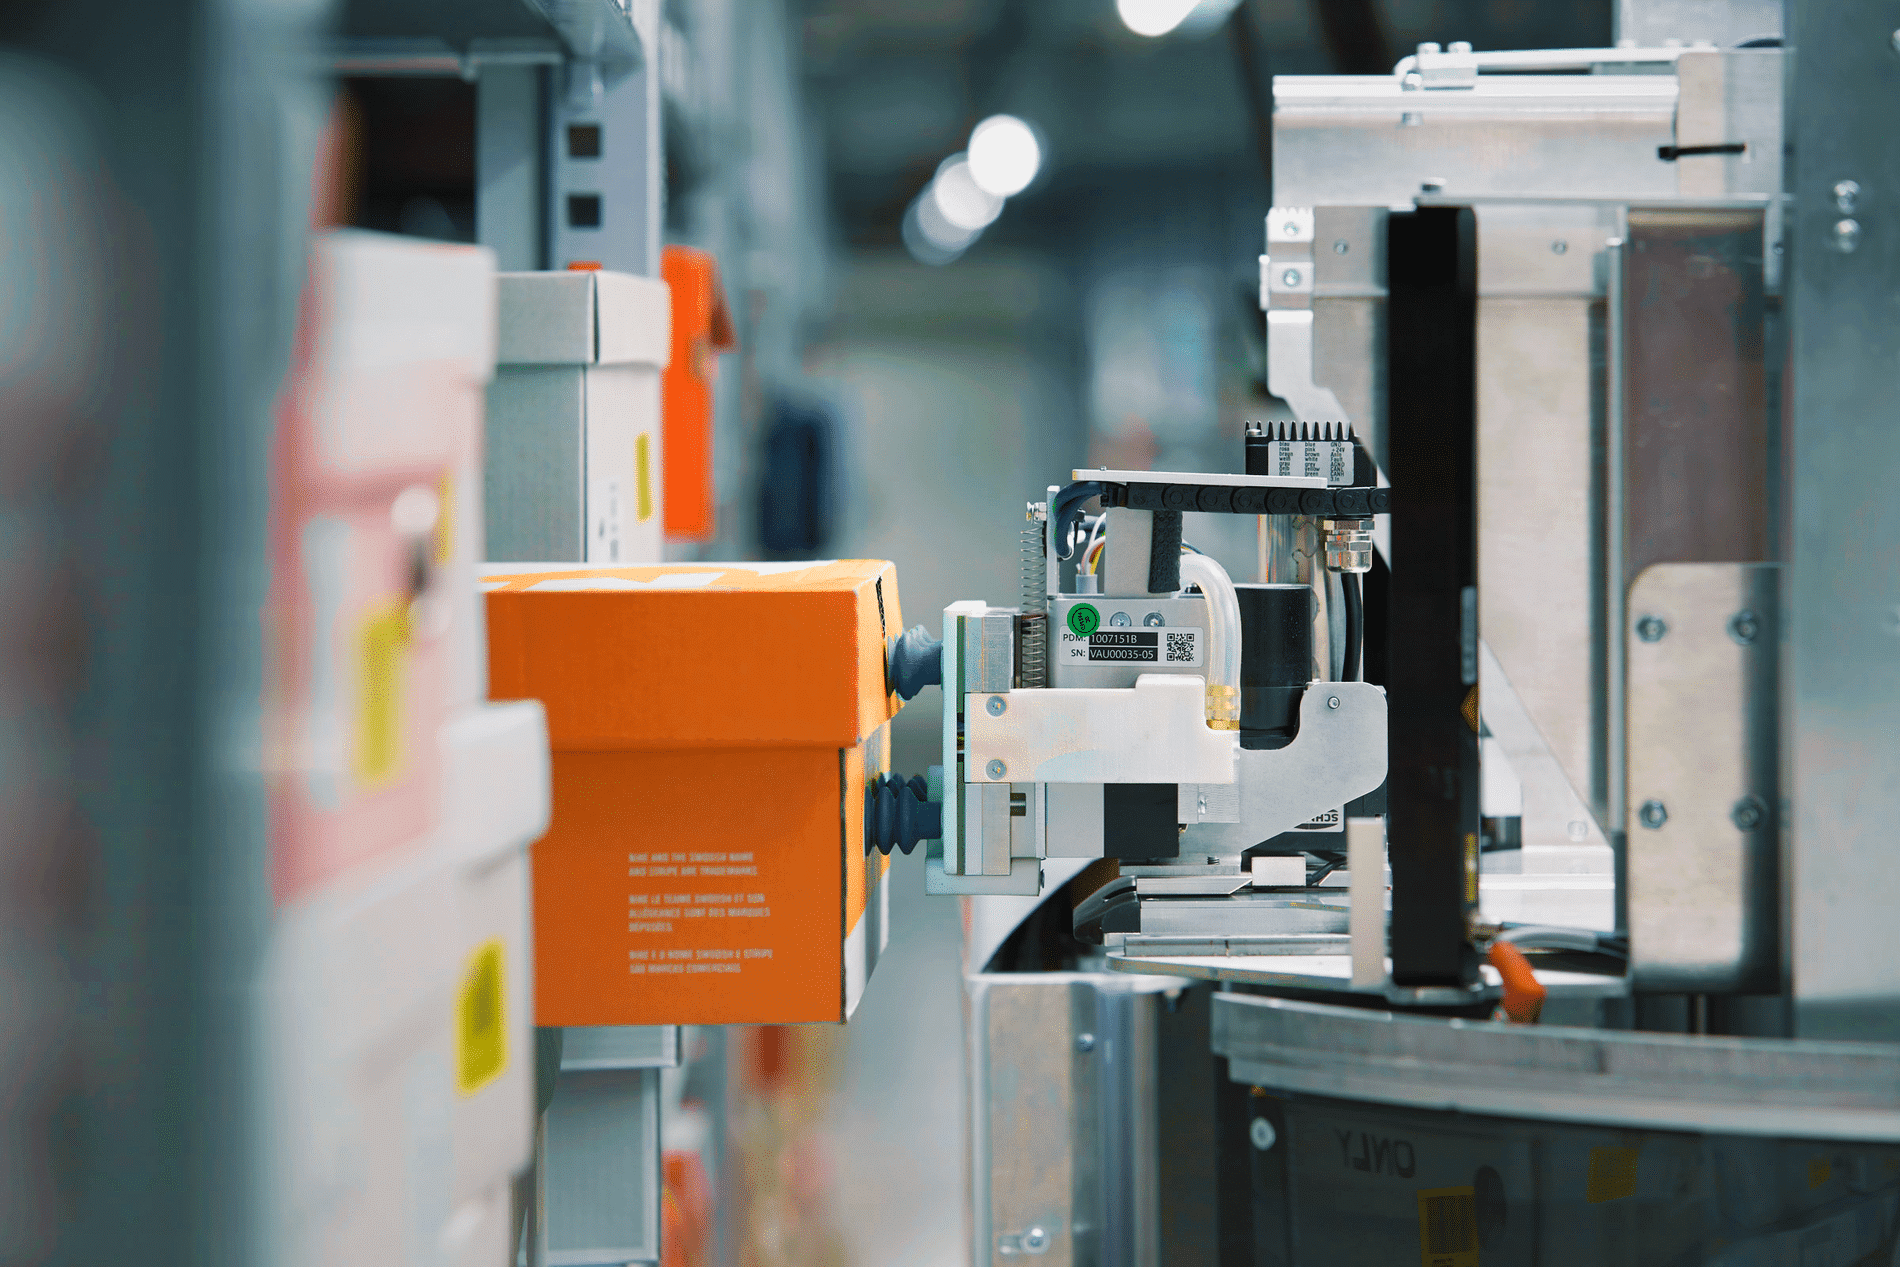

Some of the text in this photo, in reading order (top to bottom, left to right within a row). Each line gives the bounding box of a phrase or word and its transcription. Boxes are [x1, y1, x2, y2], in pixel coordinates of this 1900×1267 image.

[1063, 634, 1138, 644] PDM: 1007151B
[1071, 649, 1154, 659] SN: VAU00035-05
